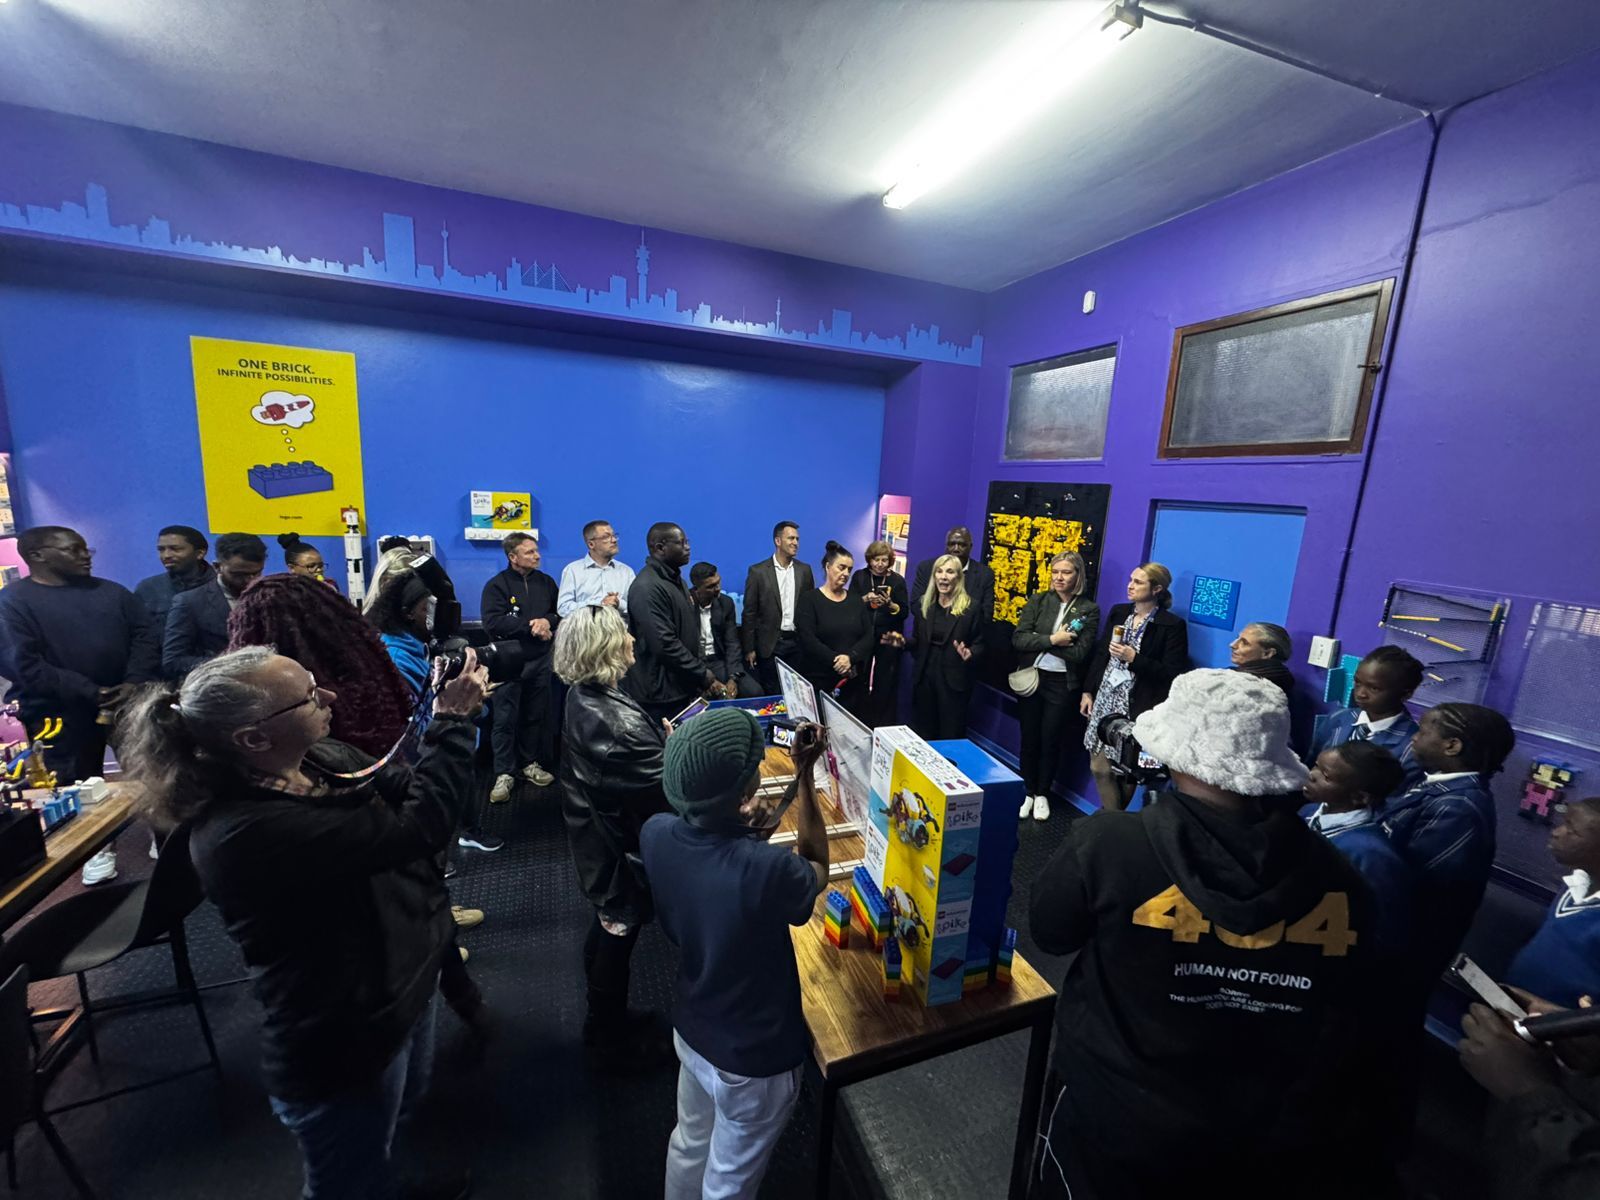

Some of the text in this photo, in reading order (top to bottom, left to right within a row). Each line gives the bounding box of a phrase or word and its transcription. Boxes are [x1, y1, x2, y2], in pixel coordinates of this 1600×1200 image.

[238, 358, 315, 375] ONE BRICK.
[217, 368, 336, 386] INFINITE POSSIBILITIES.
[1174, 962, 1312, 990] HUMAN NOT FOUND
